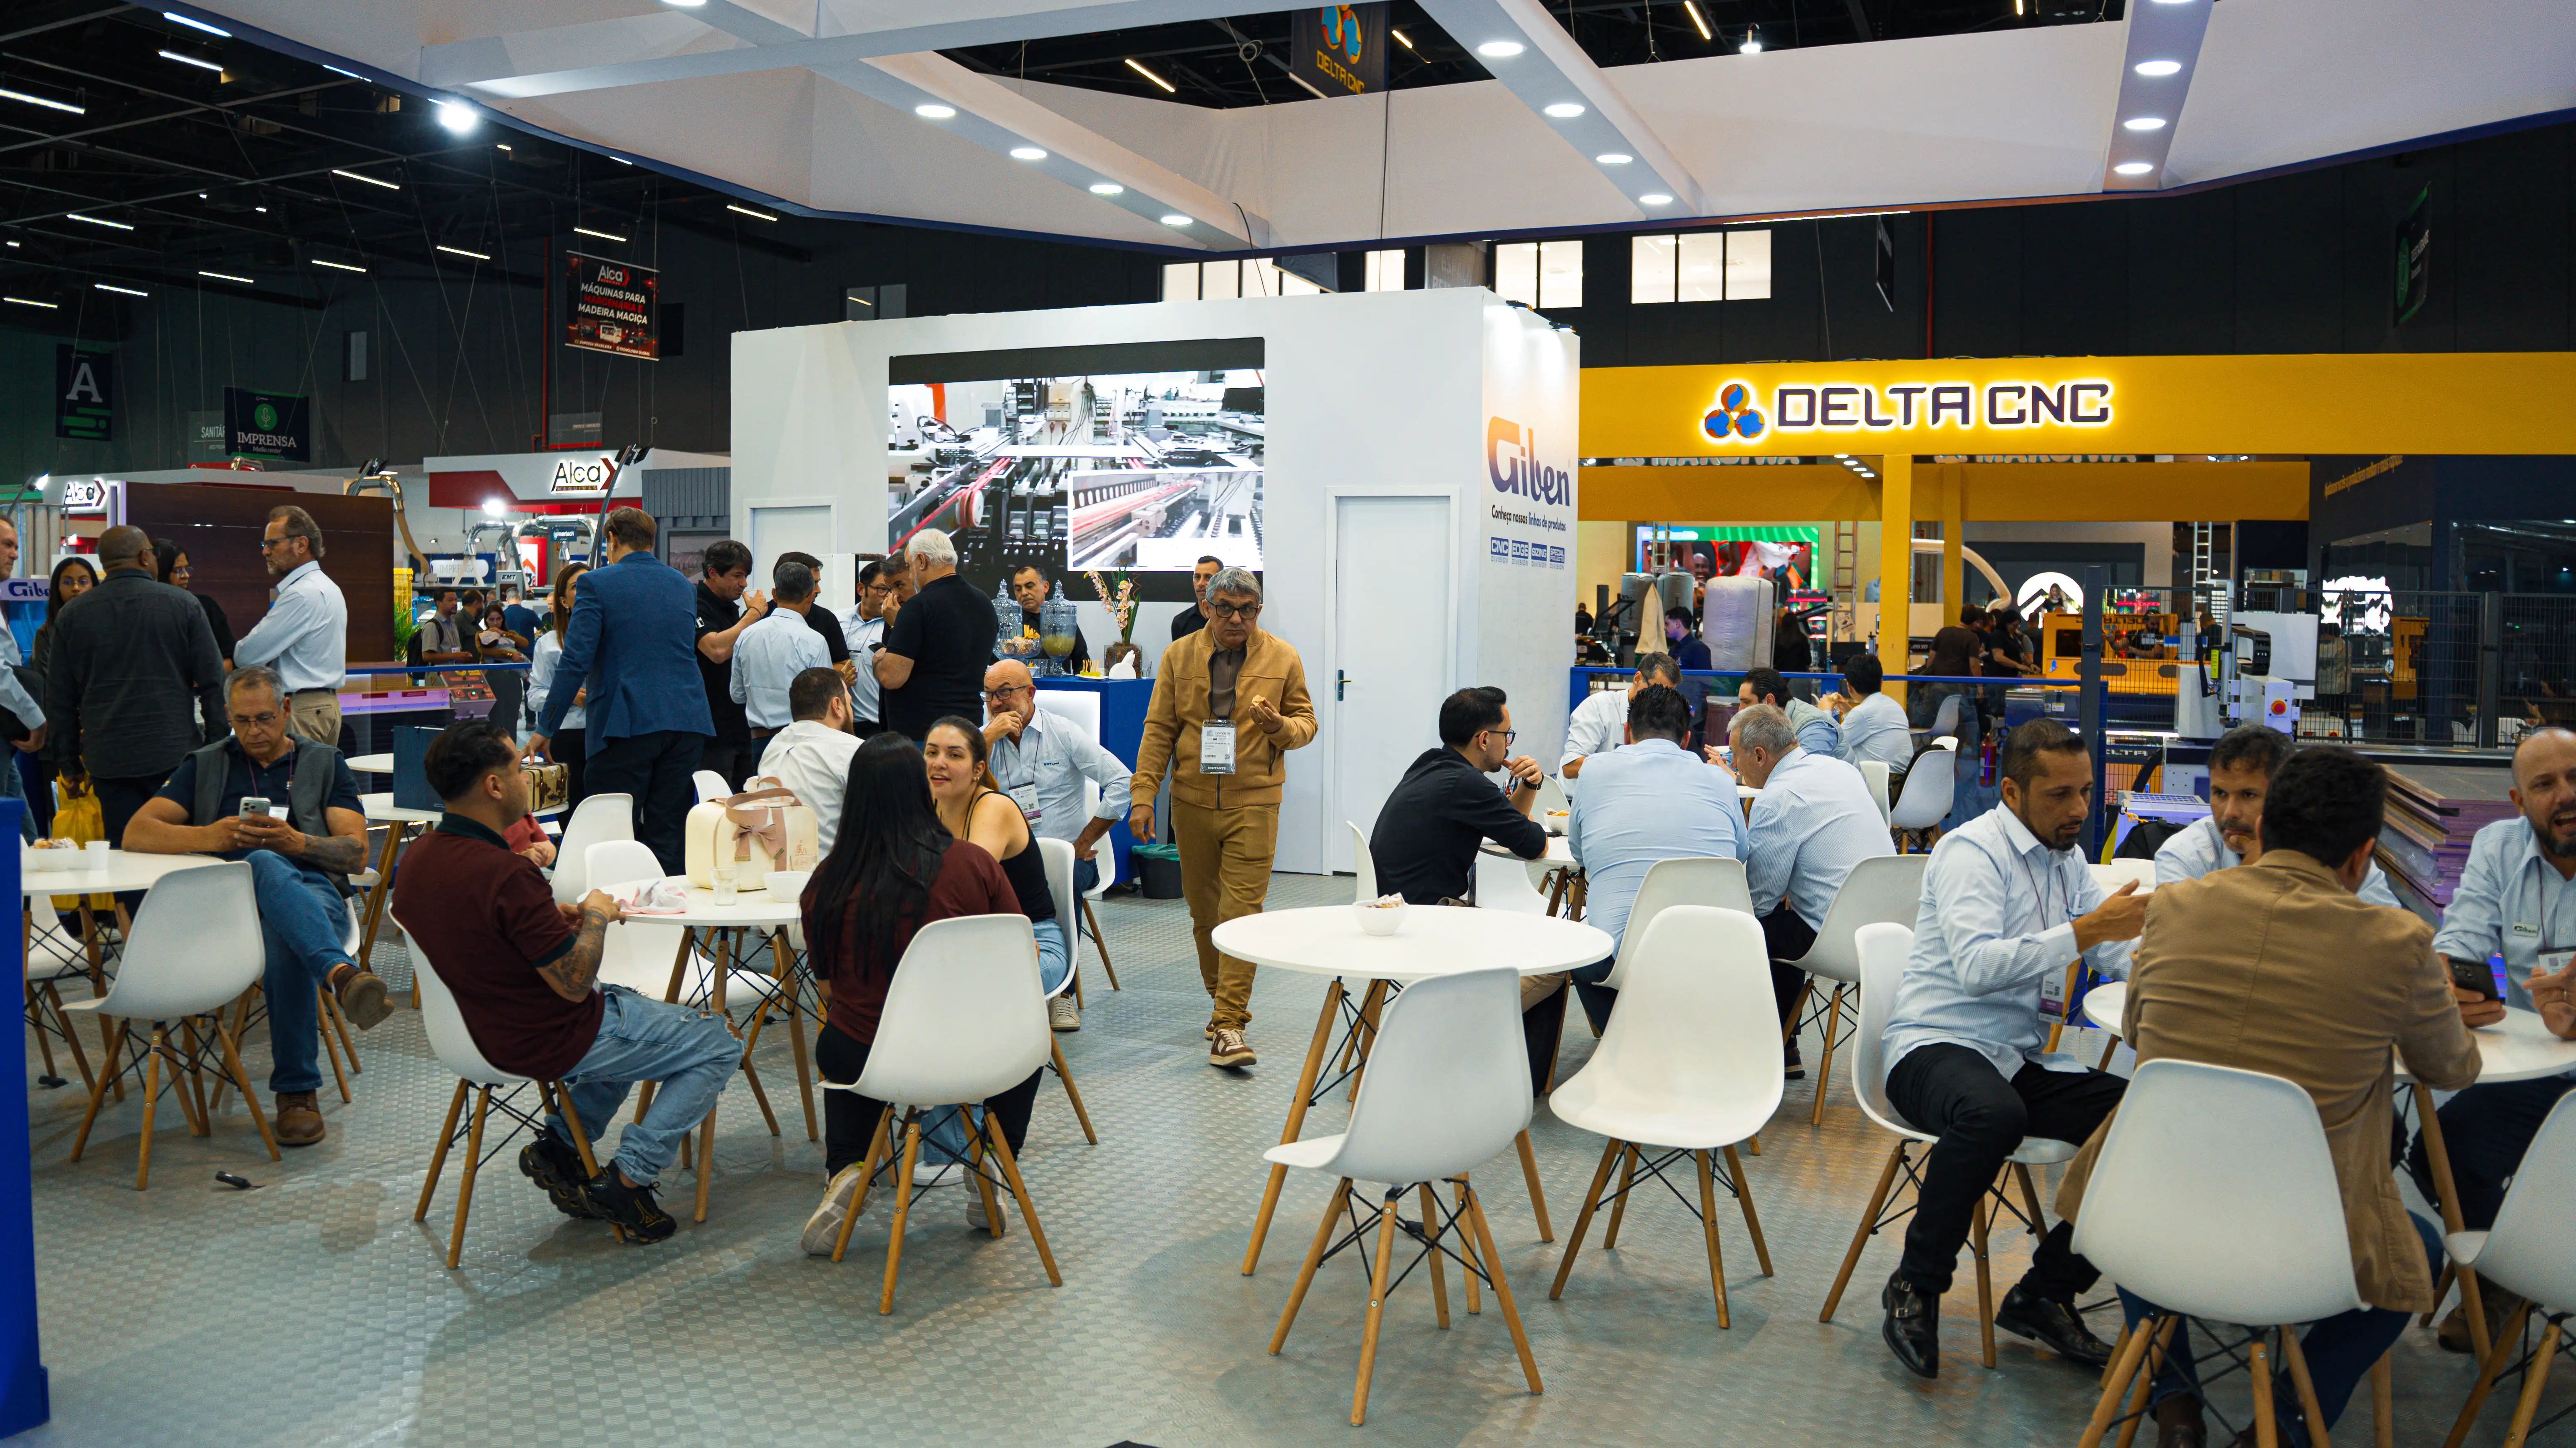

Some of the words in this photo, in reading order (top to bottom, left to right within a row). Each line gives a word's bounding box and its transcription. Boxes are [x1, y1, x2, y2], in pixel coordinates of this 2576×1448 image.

[1317, 50, 1347, 86] DELTA
[1347, 73, 1365, 95] CNC
[597, 265, 623, 283] Alca
[581, 282, 624, 299] MÁQUINAS
[625, 292, 646, 304] PARA
[578, 303, 615, 318] MADEIRA
[616, 311, 648, 325] MACIÇA
[583, 294, 636, 312] MARCENARIA
[638, 305, 644, 314] E
[66, 362, 103, 403] A
[1778, 385, 1971, 427] DELTA
[1989, 384, 2109, 425] CNC
[237, 431, 297, 448] IMPRENSA
[1487, 416, 1570, 507] Giben
[551, 462, 601, 492] Alca
[1491, 504, 1512, 526] Conheça
[1513, 513, 1528, 524] nossas
[1528, 511, 1541, 527] linhas
[1542, 515, 1547, 528] de
[1548, 517, 1566, 532] produtos
[1491, 539, 1508, 554] CNC
[1512, 543, 1528, 557] EDGE
[1532, 548, 1547, 558] SIZING
[1550, 548, 1564, 557] SPECIAL
[439, 564, 475, 574] IMPRS
